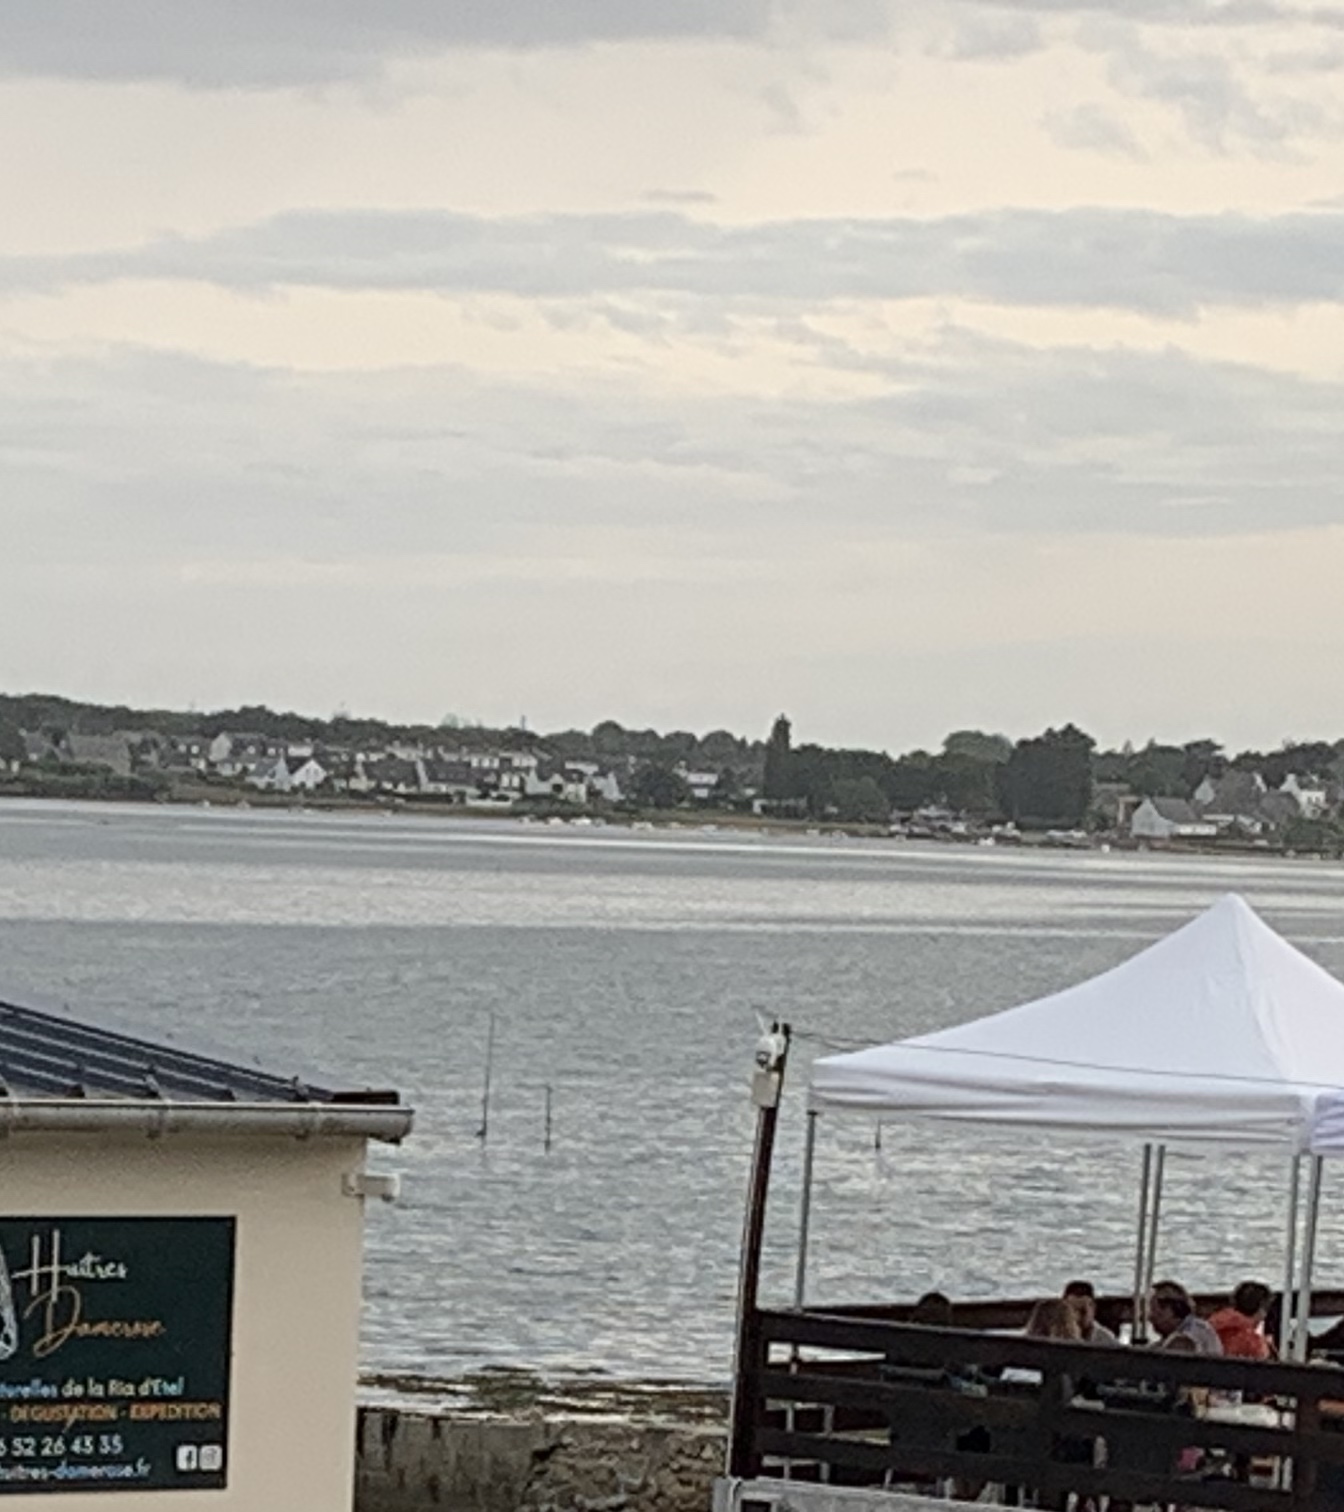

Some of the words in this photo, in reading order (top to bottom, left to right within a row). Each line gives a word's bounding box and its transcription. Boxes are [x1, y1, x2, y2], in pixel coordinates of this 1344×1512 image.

[61, 1377, 85, 1398] de
[87, 1376, 105, 1397] la
[107, 1378, 136, 1397] Ria
[11, 1436, 37, 1457] 52
[40, 1435, 67, 1457] 26
